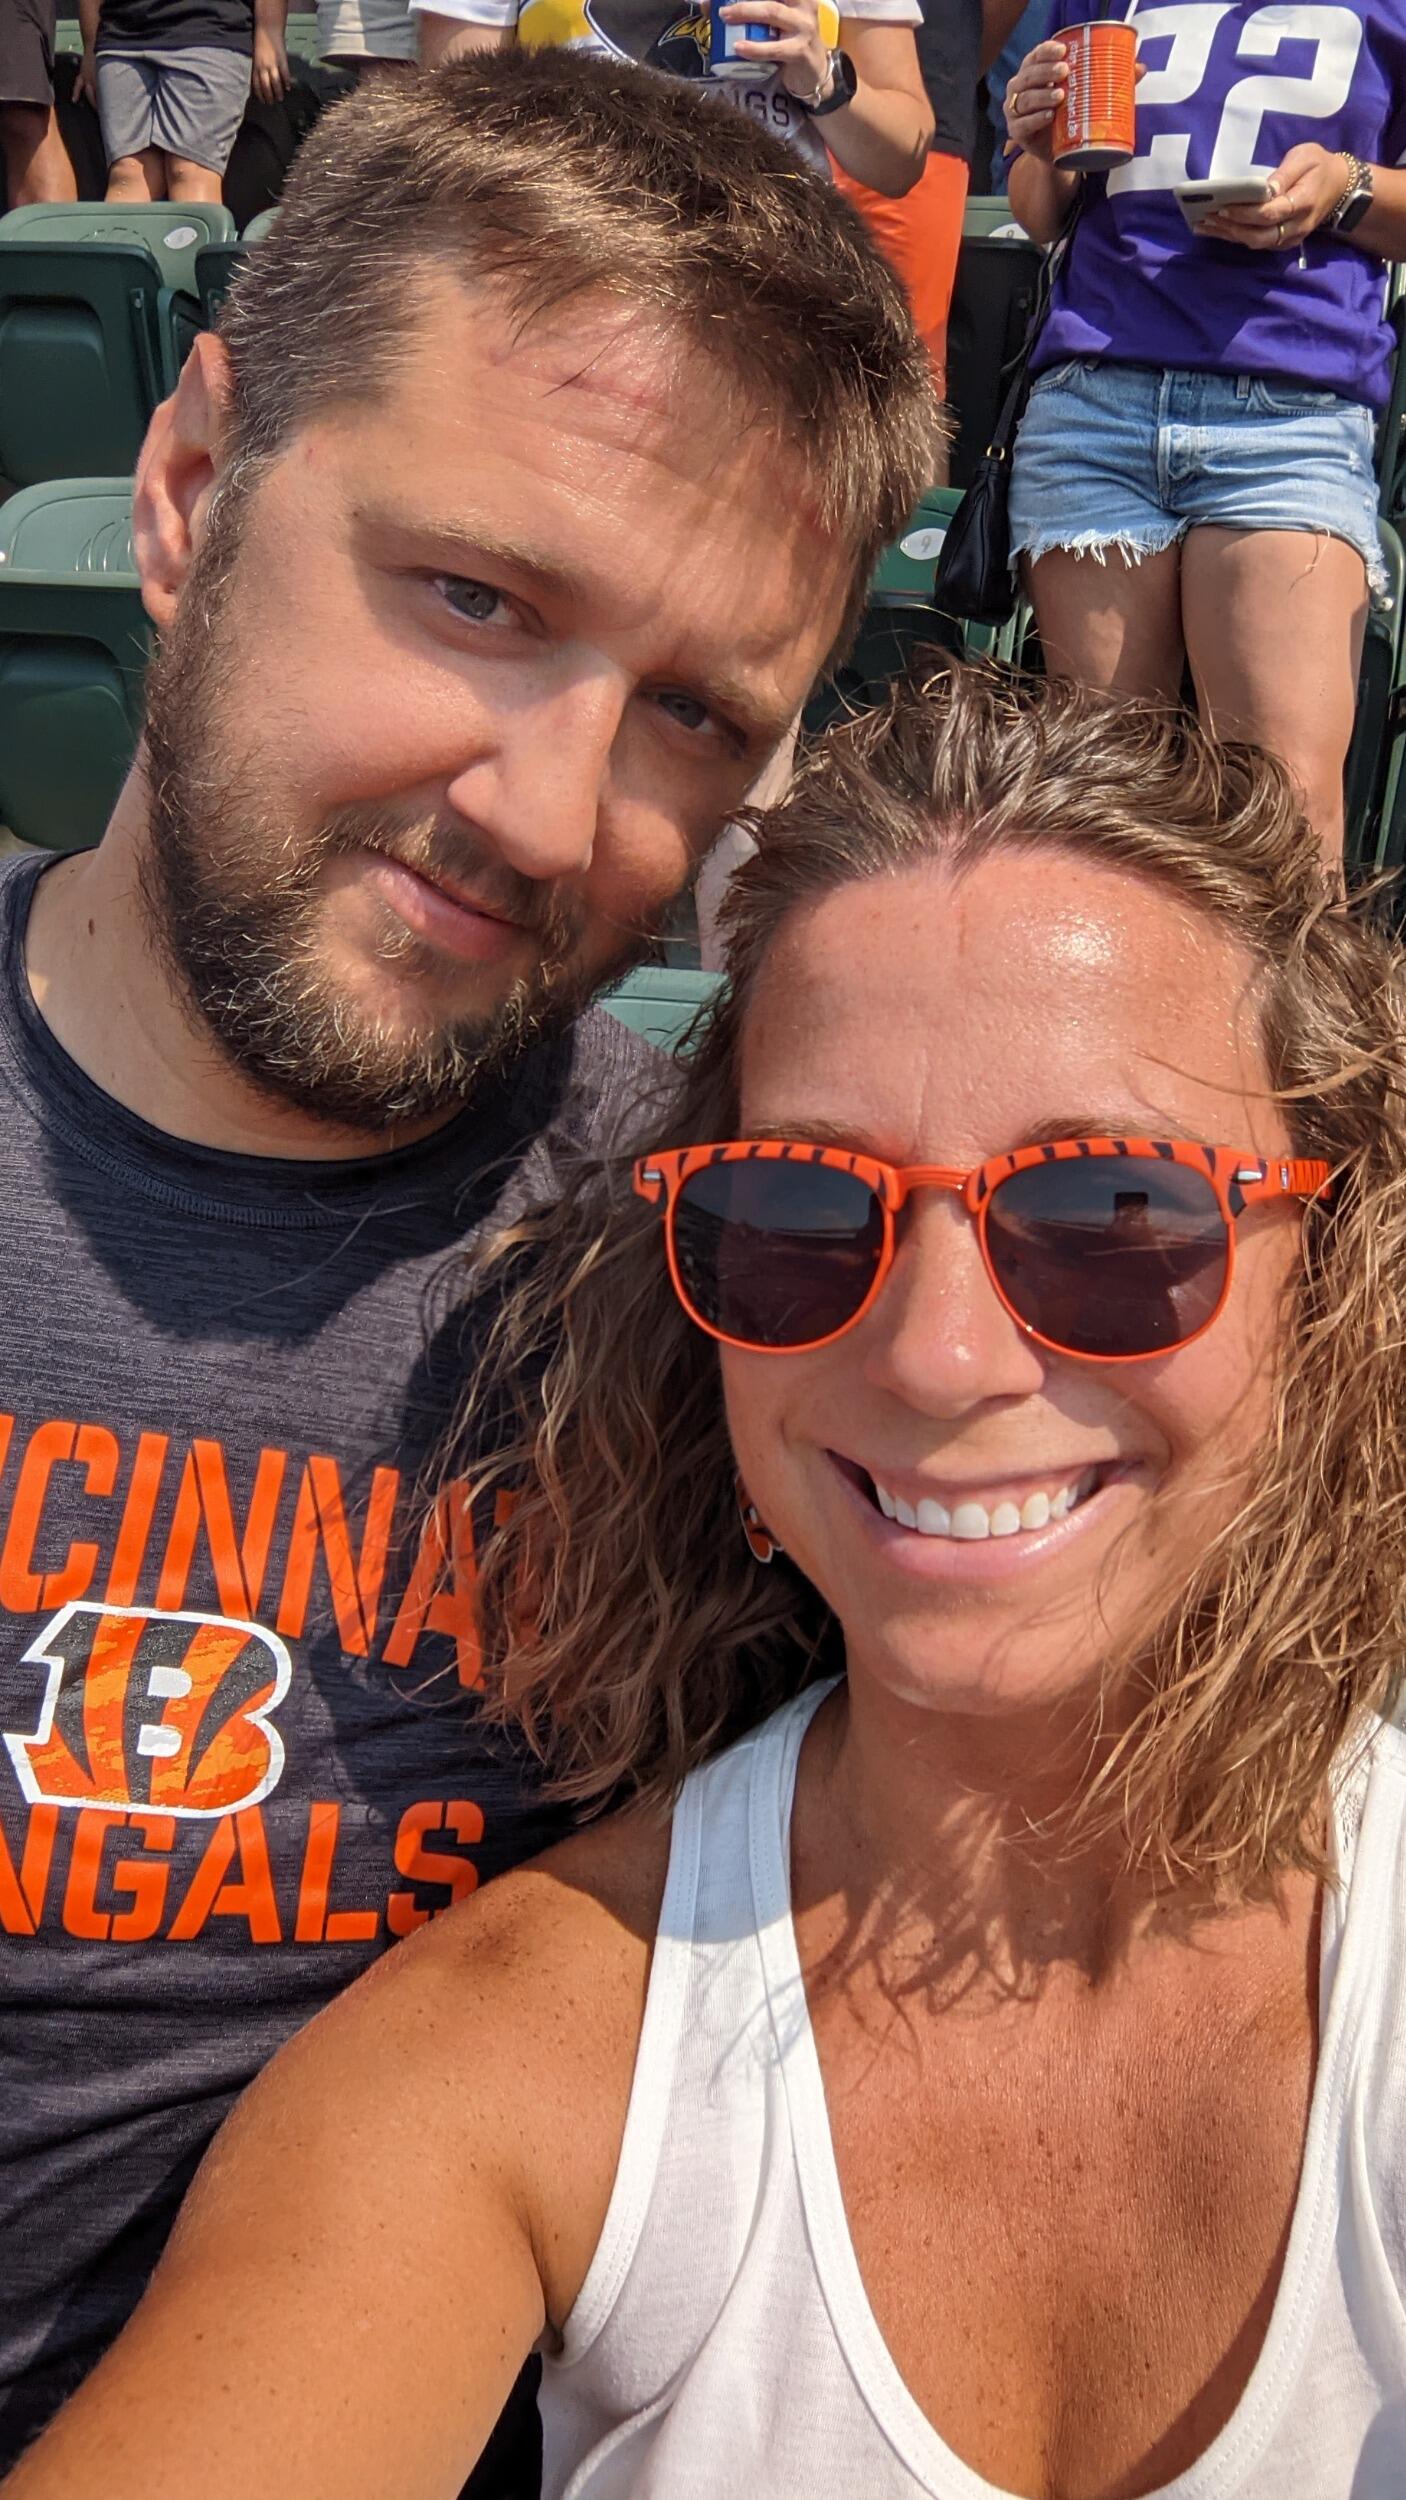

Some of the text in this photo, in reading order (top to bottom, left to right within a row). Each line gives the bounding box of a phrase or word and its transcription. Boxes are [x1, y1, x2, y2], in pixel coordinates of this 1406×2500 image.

[1106, 3, 1363, 198] 22
[921, 534, 933, 553] 9
[0, 1413, 540, 1692] CINNA
